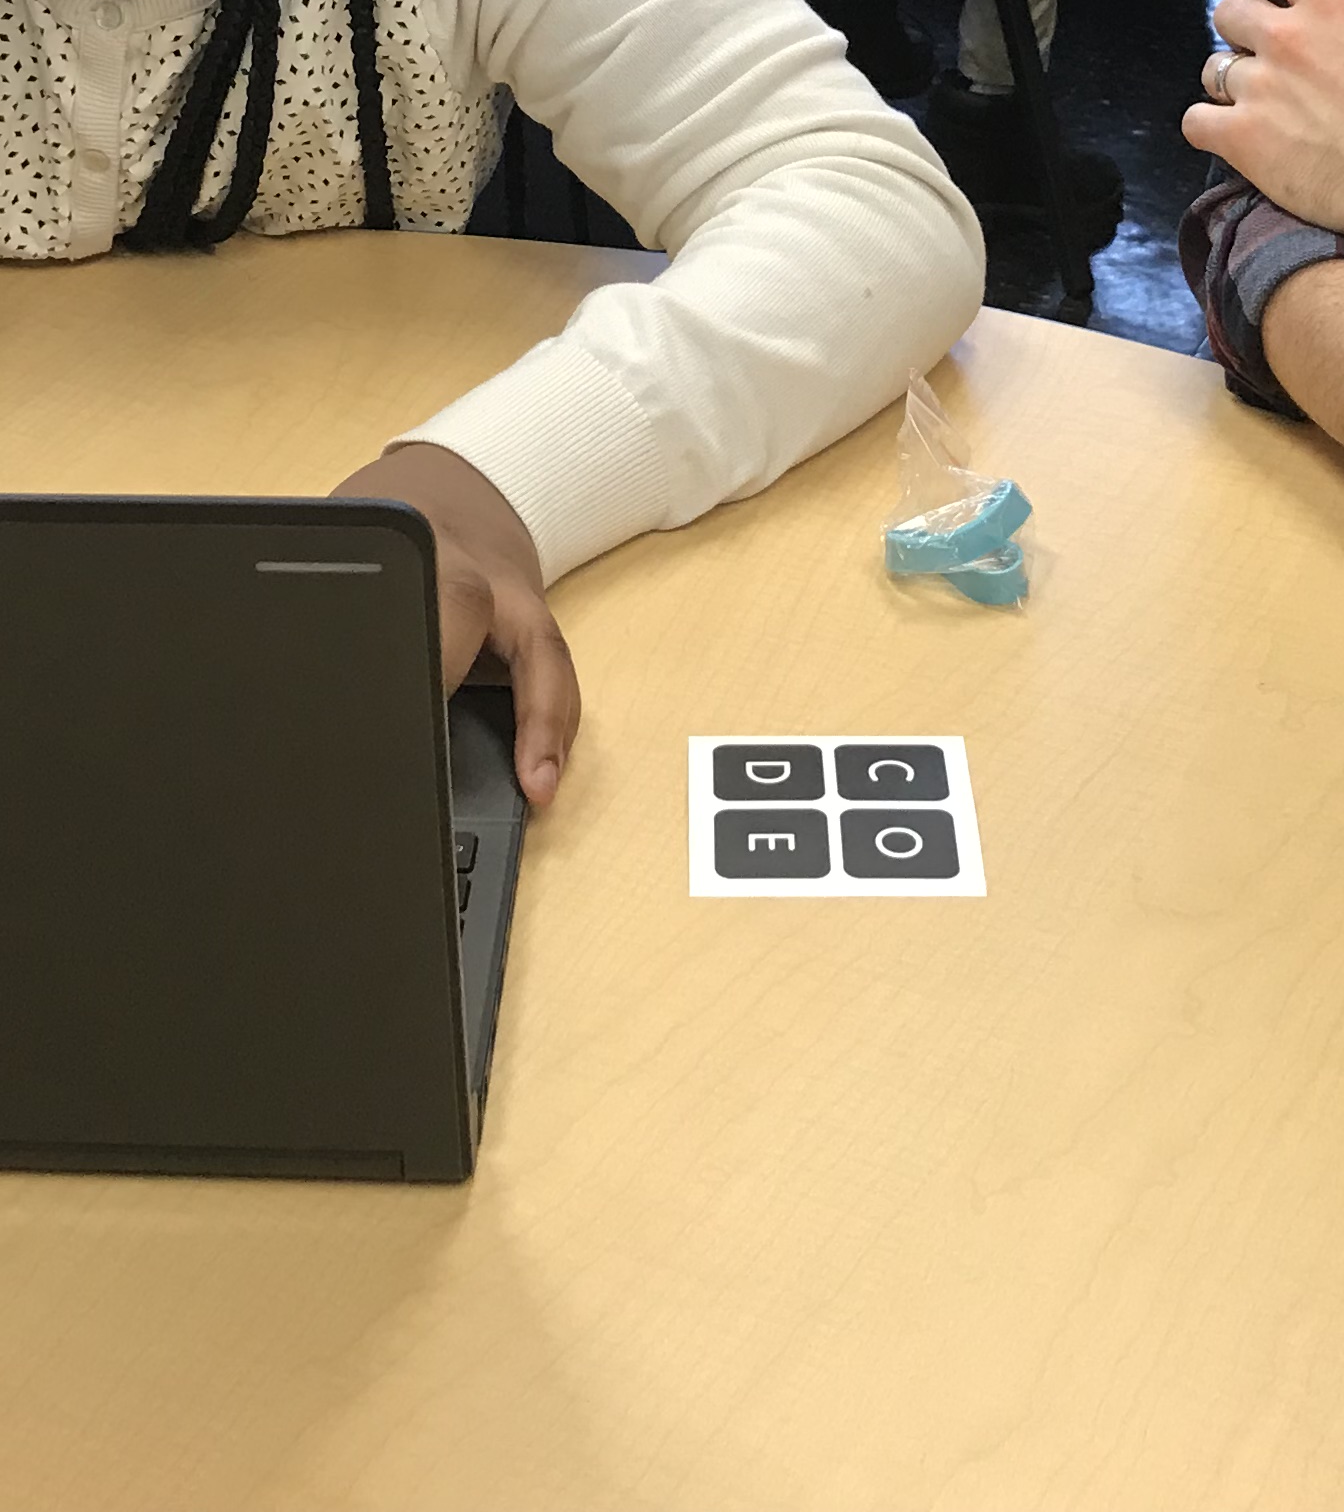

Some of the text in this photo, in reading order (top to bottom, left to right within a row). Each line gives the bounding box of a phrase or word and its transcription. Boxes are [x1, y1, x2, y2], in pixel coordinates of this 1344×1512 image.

[744, 760, 796, 852] D E
[867, 759, 923, 859] C O
